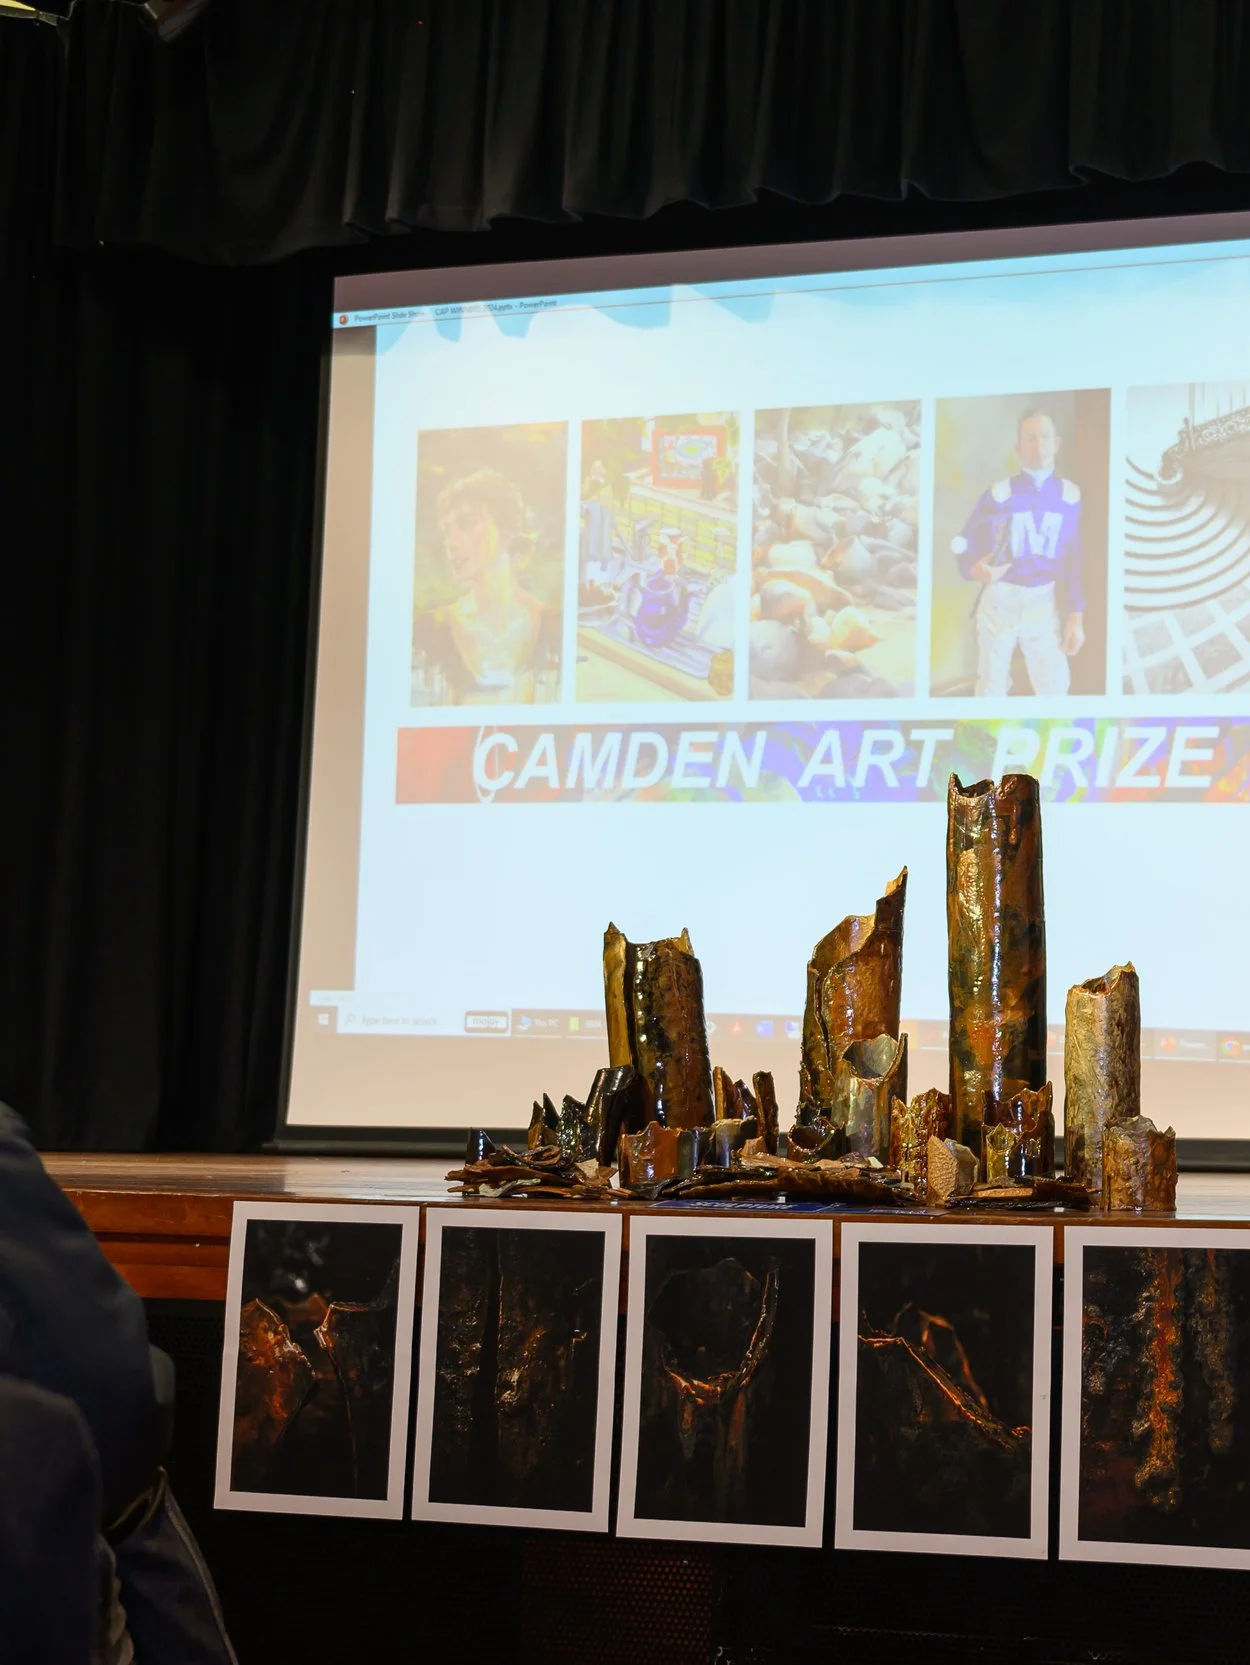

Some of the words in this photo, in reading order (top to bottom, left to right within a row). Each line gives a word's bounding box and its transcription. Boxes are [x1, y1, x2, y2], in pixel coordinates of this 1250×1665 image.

[1010, 510, 1064, 560] M
[473, 729, 768, 791] CAMDEN
[796, 727, 954, 789] ART
[990, 725, 1220, 788] PRIZE
[689, 1201, 798, 1210] SCULPTURE
